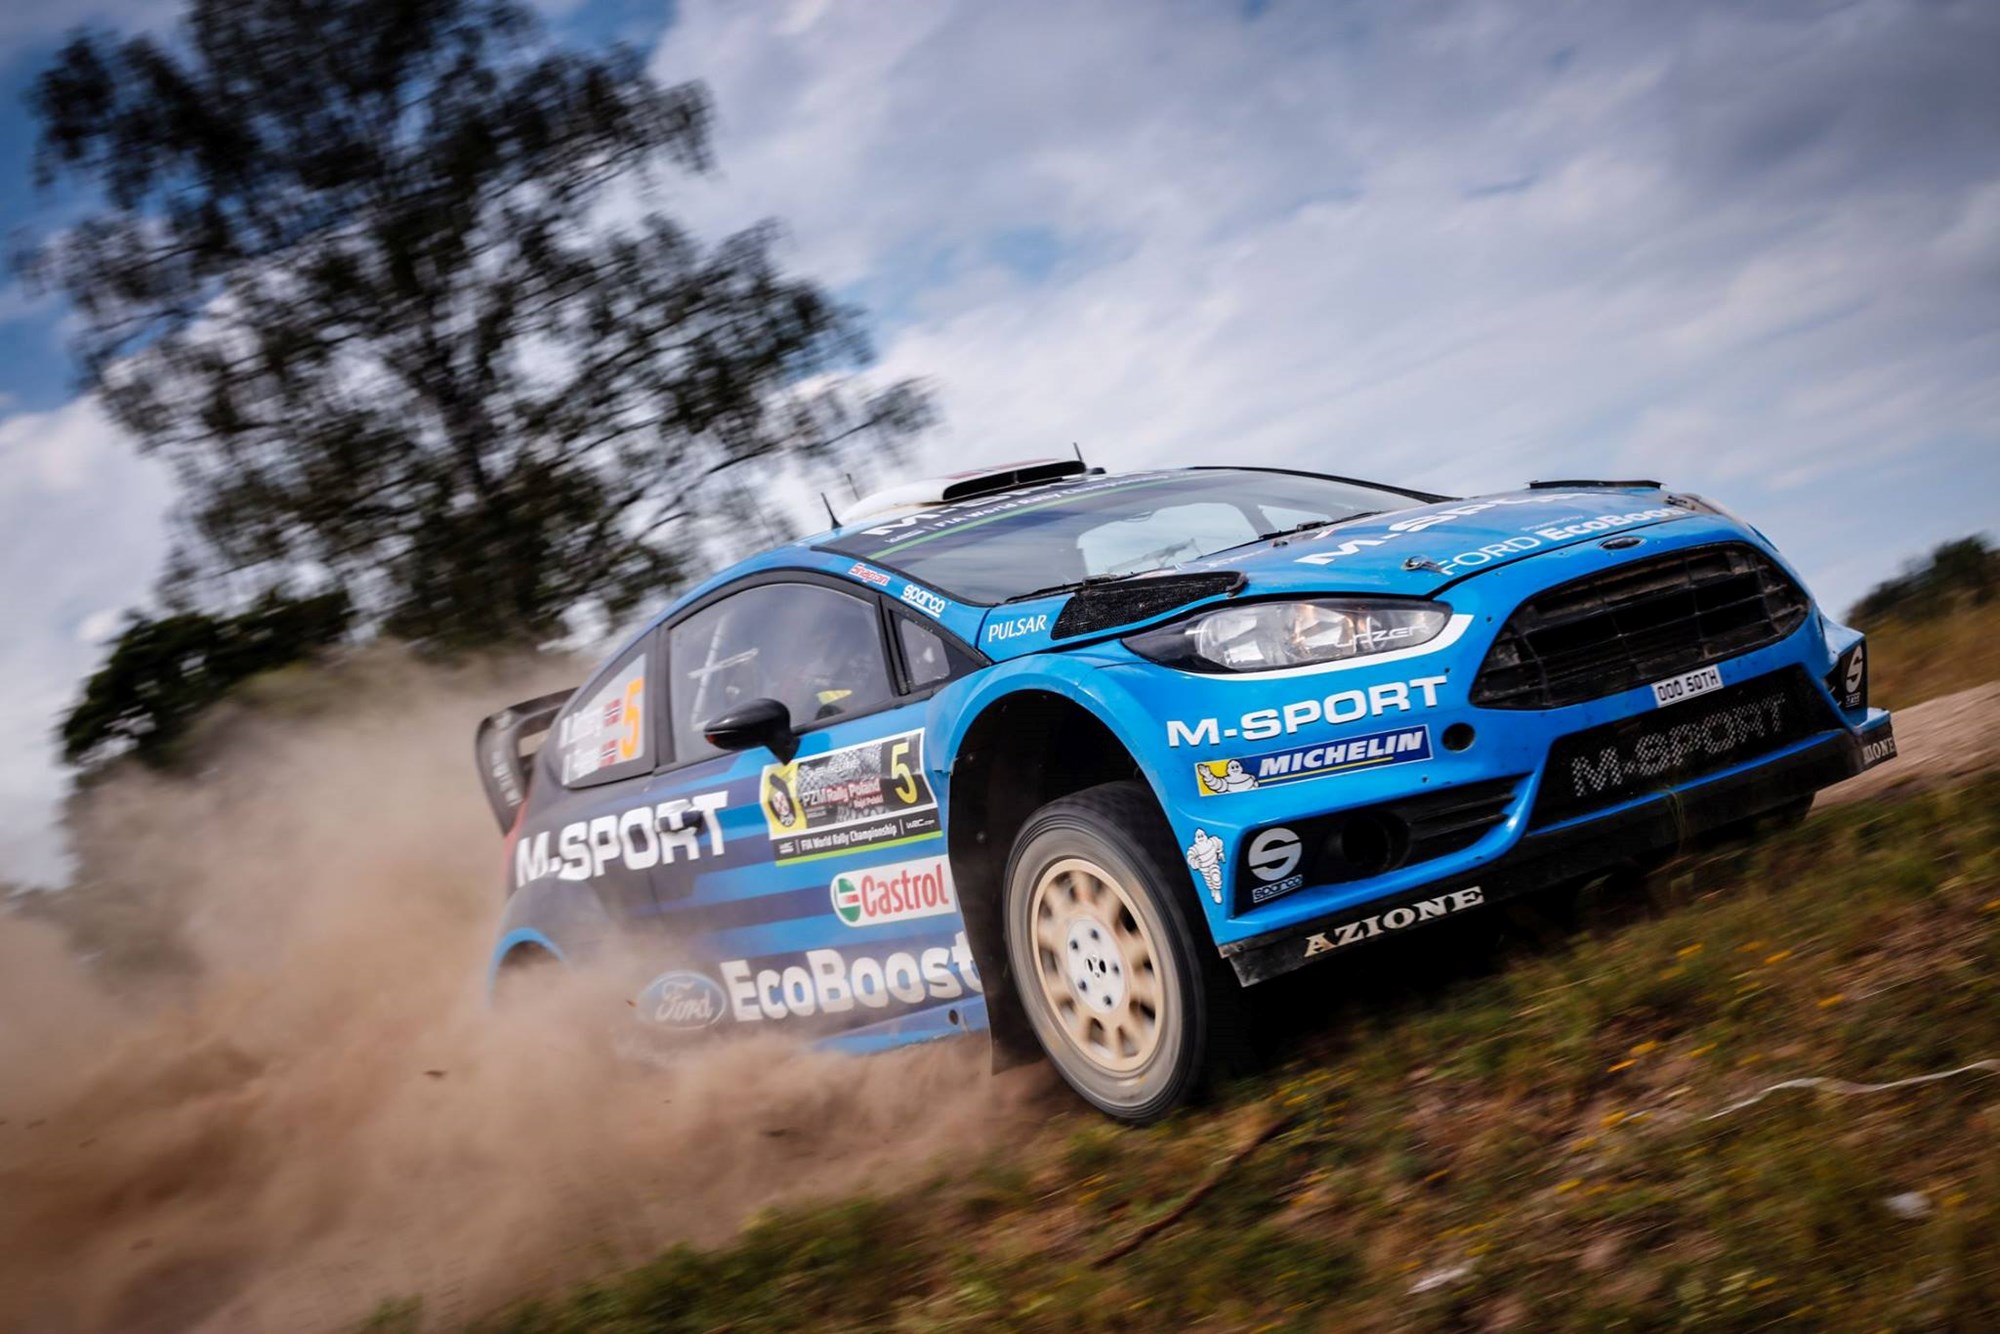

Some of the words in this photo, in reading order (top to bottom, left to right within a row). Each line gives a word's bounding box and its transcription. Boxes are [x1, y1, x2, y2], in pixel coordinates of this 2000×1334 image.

[1440, 536, 1541, 576] FORD
[903, 584, 946, 615] sparco
[987, 614, 1048, 643] PULSAR
[620, 676, 644, 758] 5
[1166, 675, 1448, 748] M-SPORT
[891, 742, 918, 804] 5
[1258, 730, 1424, 778] MICHELIN
[1571, 692, 1786, 797] M-SPORT
[861, 864, 949, 918] Castrol
[1304, 885, 1485, 957] AZIONE
[654, 980, 713, 1023] Ford
[719, 931, 983, 1023] EcoBoost
